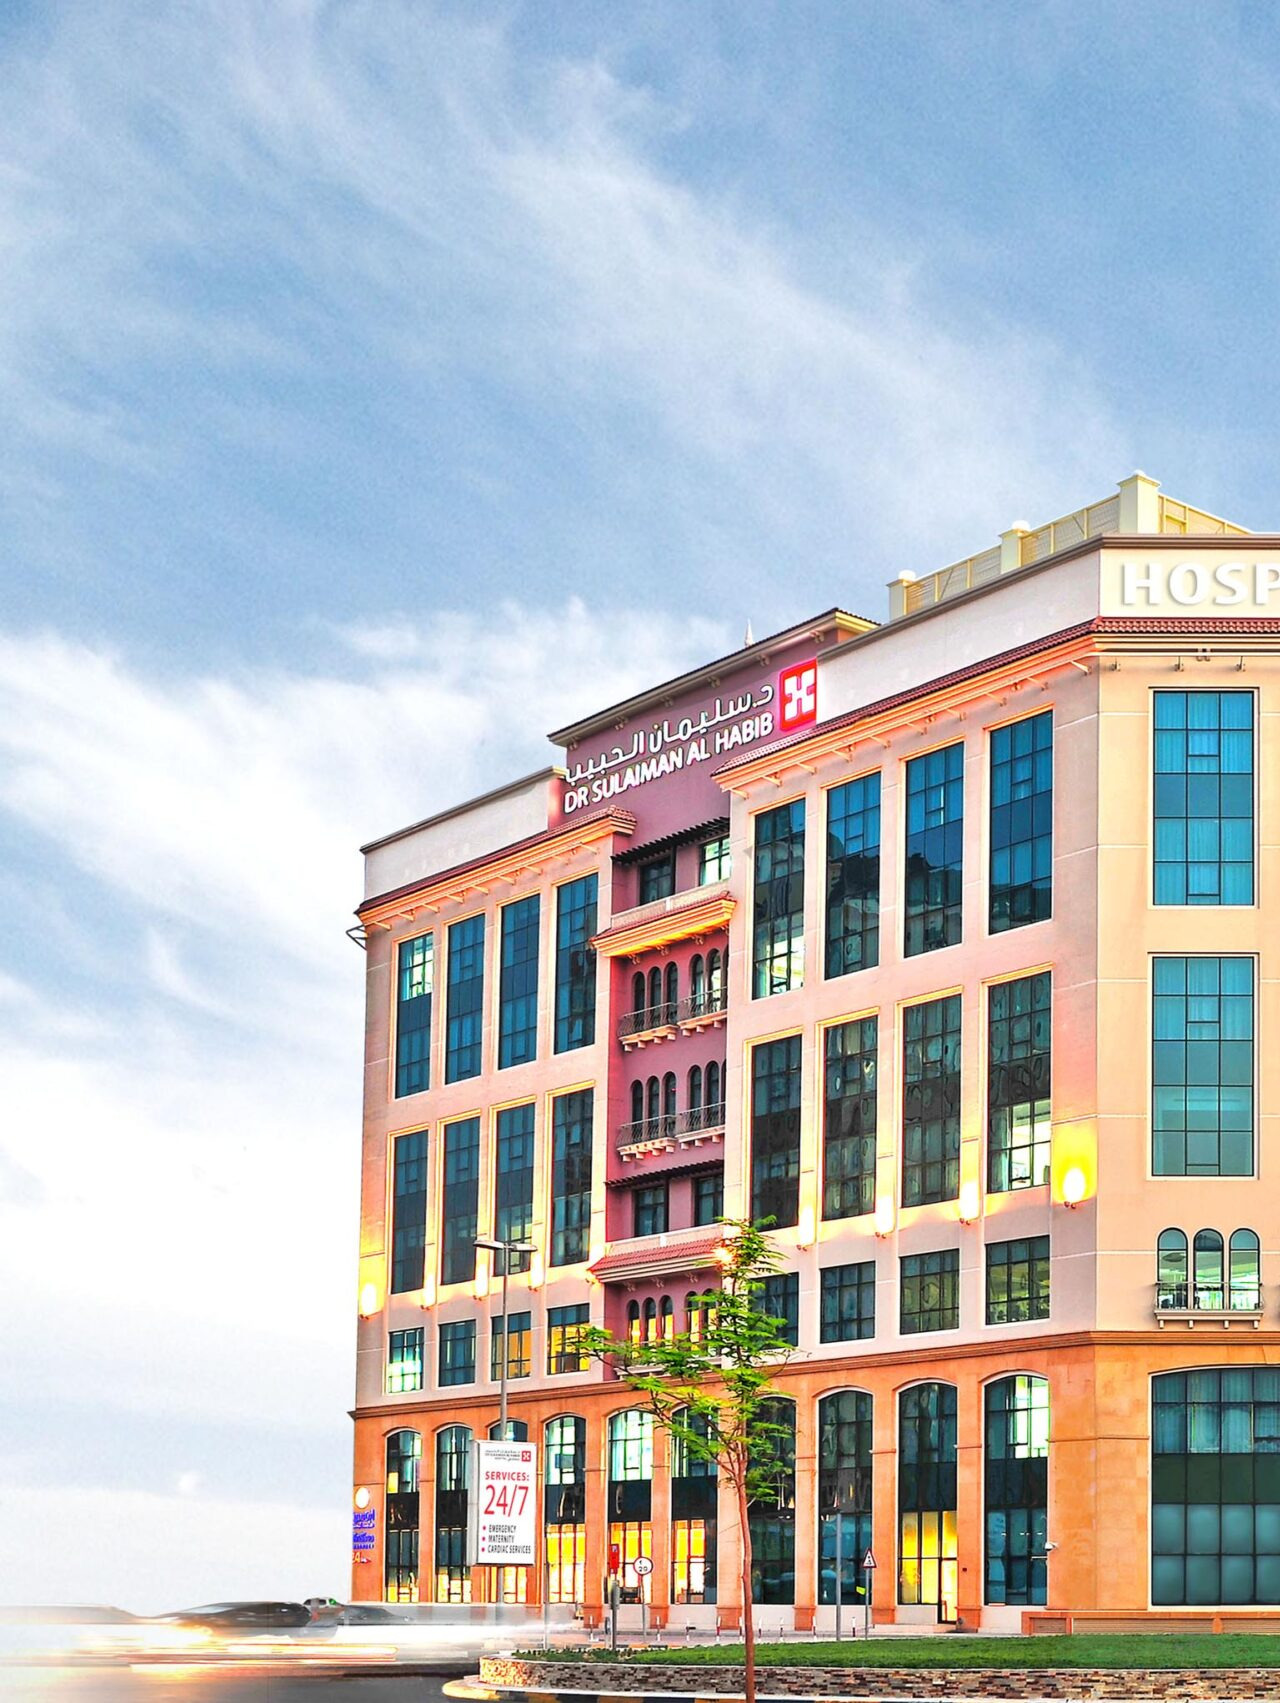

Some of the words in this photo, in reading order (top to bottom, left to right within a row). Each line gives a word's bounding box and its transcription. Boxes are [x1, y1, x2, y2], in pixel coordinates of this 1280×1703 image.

[563, 786, 590, 814] DR
[591, 747, 684, 804] SULAIMAN
[685, 738, 712, 767] AL
[715, 711, 775, 755] HABIB
[564, 730, 646, 787] الحبيب
[485, 1471, 530, 1482] SERVICES:
[484, 1483, 530, 1517] 24/7
